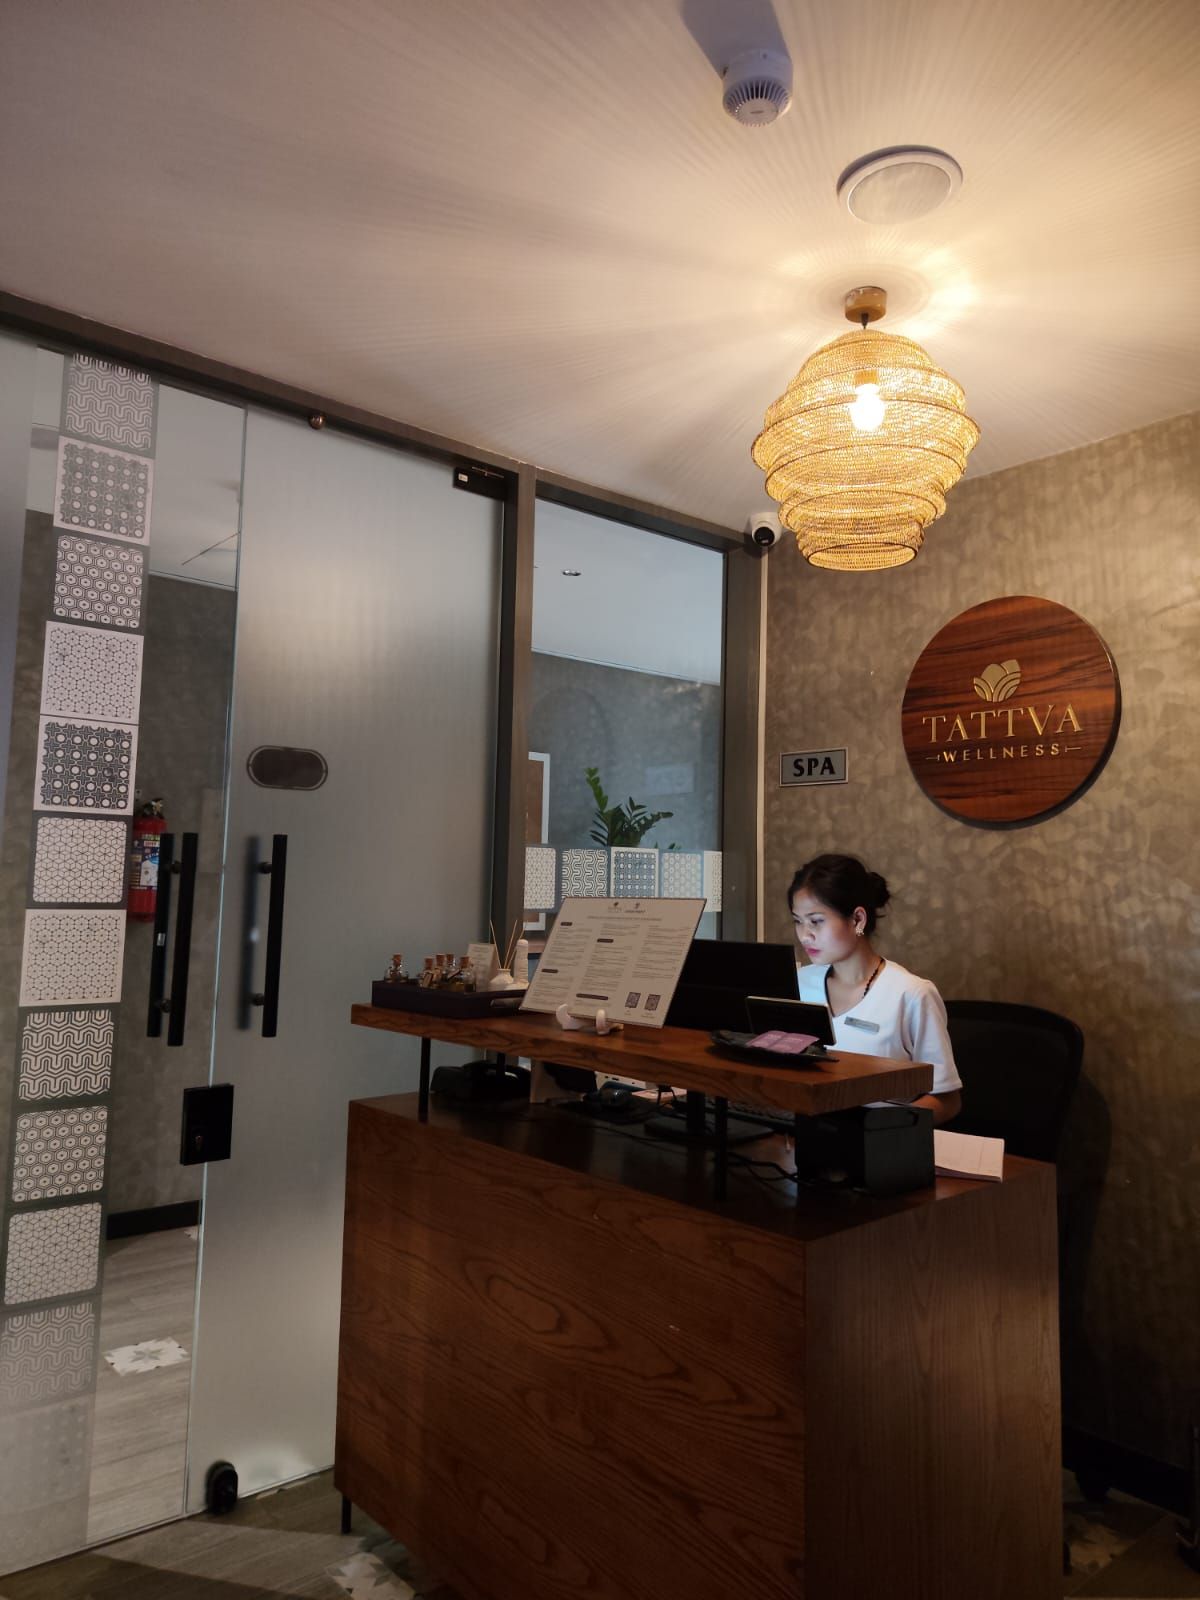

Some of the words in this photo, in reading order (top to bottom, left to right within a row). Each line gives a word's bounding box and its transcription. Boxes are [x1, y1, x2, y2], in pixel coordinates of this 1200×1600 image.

[922, 703, 1084, 743] TATTVA
[943, 743, 1060, 763] WELLNESS
[793, 757, 836, 777] SPA
